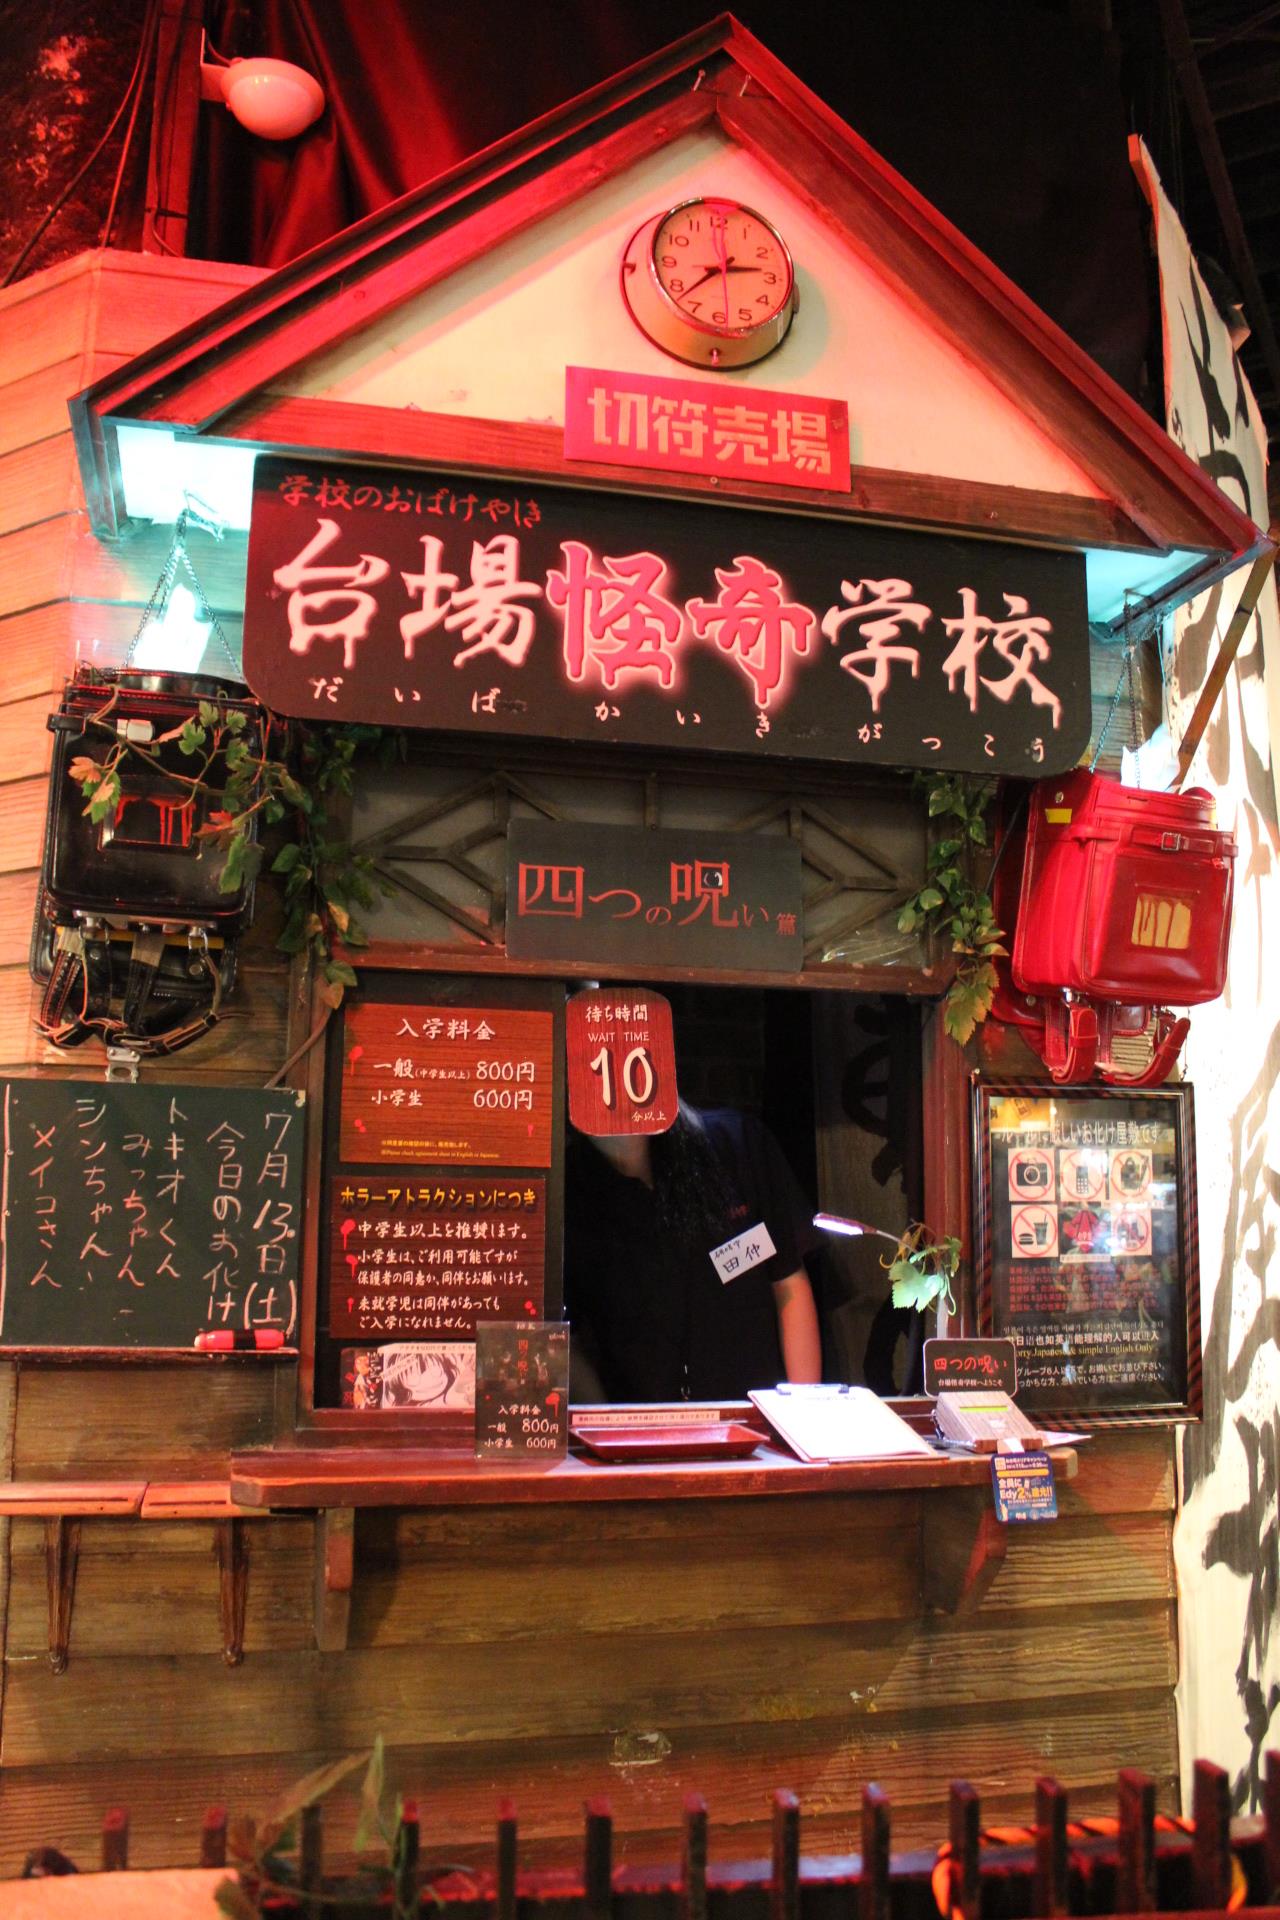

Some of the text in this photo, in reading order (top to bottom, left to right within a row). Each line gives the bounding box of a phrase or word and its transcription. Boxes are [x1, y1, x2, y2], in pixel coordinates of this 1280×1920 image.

[689, 219, 700, 232] 11
[710, 216, 728, 230] 12
[669, 234, 689, 247] 10
[756, 247, 768, 259] 2
[662, 256, 677, 268] 9
[669, 279, 684, 293] 8
[763, 272, 776, 285] 3
[688, 300, 702, 313] 7
[755, 294, 769, 306] 4
[712, 311, 726, 324] 6
[738, 308, 752, 321] 5
[587, 387, 832, 475] 切符売場
[278, 475, 541, 529] 学校のおばけやしき
[273, 518, 1062, 730] 台場怪奇学校
[313, 675, 499, 714] だいば
[595, 701, 771, 739] かいき
[585, 1004, 648, 1023] 待ち時間
[395, 1017, 496, 1041] 入学料金
[588, 1031, 650, 1043] WAIT TIME
[476, 1060, 535, 1083] 800円
[590, 1046, 654, 1107] 10
[371, 1089, 533, 1111] 小学生 600円
[631, 1110, 666, 1122] 分以上
[156, 1097, 188, 1278] トキオくん
[340, 1186, 537, 1206] ホラーアトラクションにつき
[203, 1121, 246, 1322] 今日のお化け
[244, 1112, 297, 1339] 7月13日(土)
[358, 1221, 528, 1239] 中学生以上を推奨します。
[357, 1249, 518, 1265] 小学生は、ご利用可能ですが
[723, 1243, 760, 1273] 田仲
[358, 1296, 500, 1312] 未就学児は同伴があっても
[359, 1316, 471, 1330] ご入学になれません。
[934, 1355, 1007, 1374] 四つの呪い
[498, 1403, 541, 1416] 入学料金
[522, 1418, 559, 1434] 800円
[484, 1438, 556, 1449] 小学生 600円
